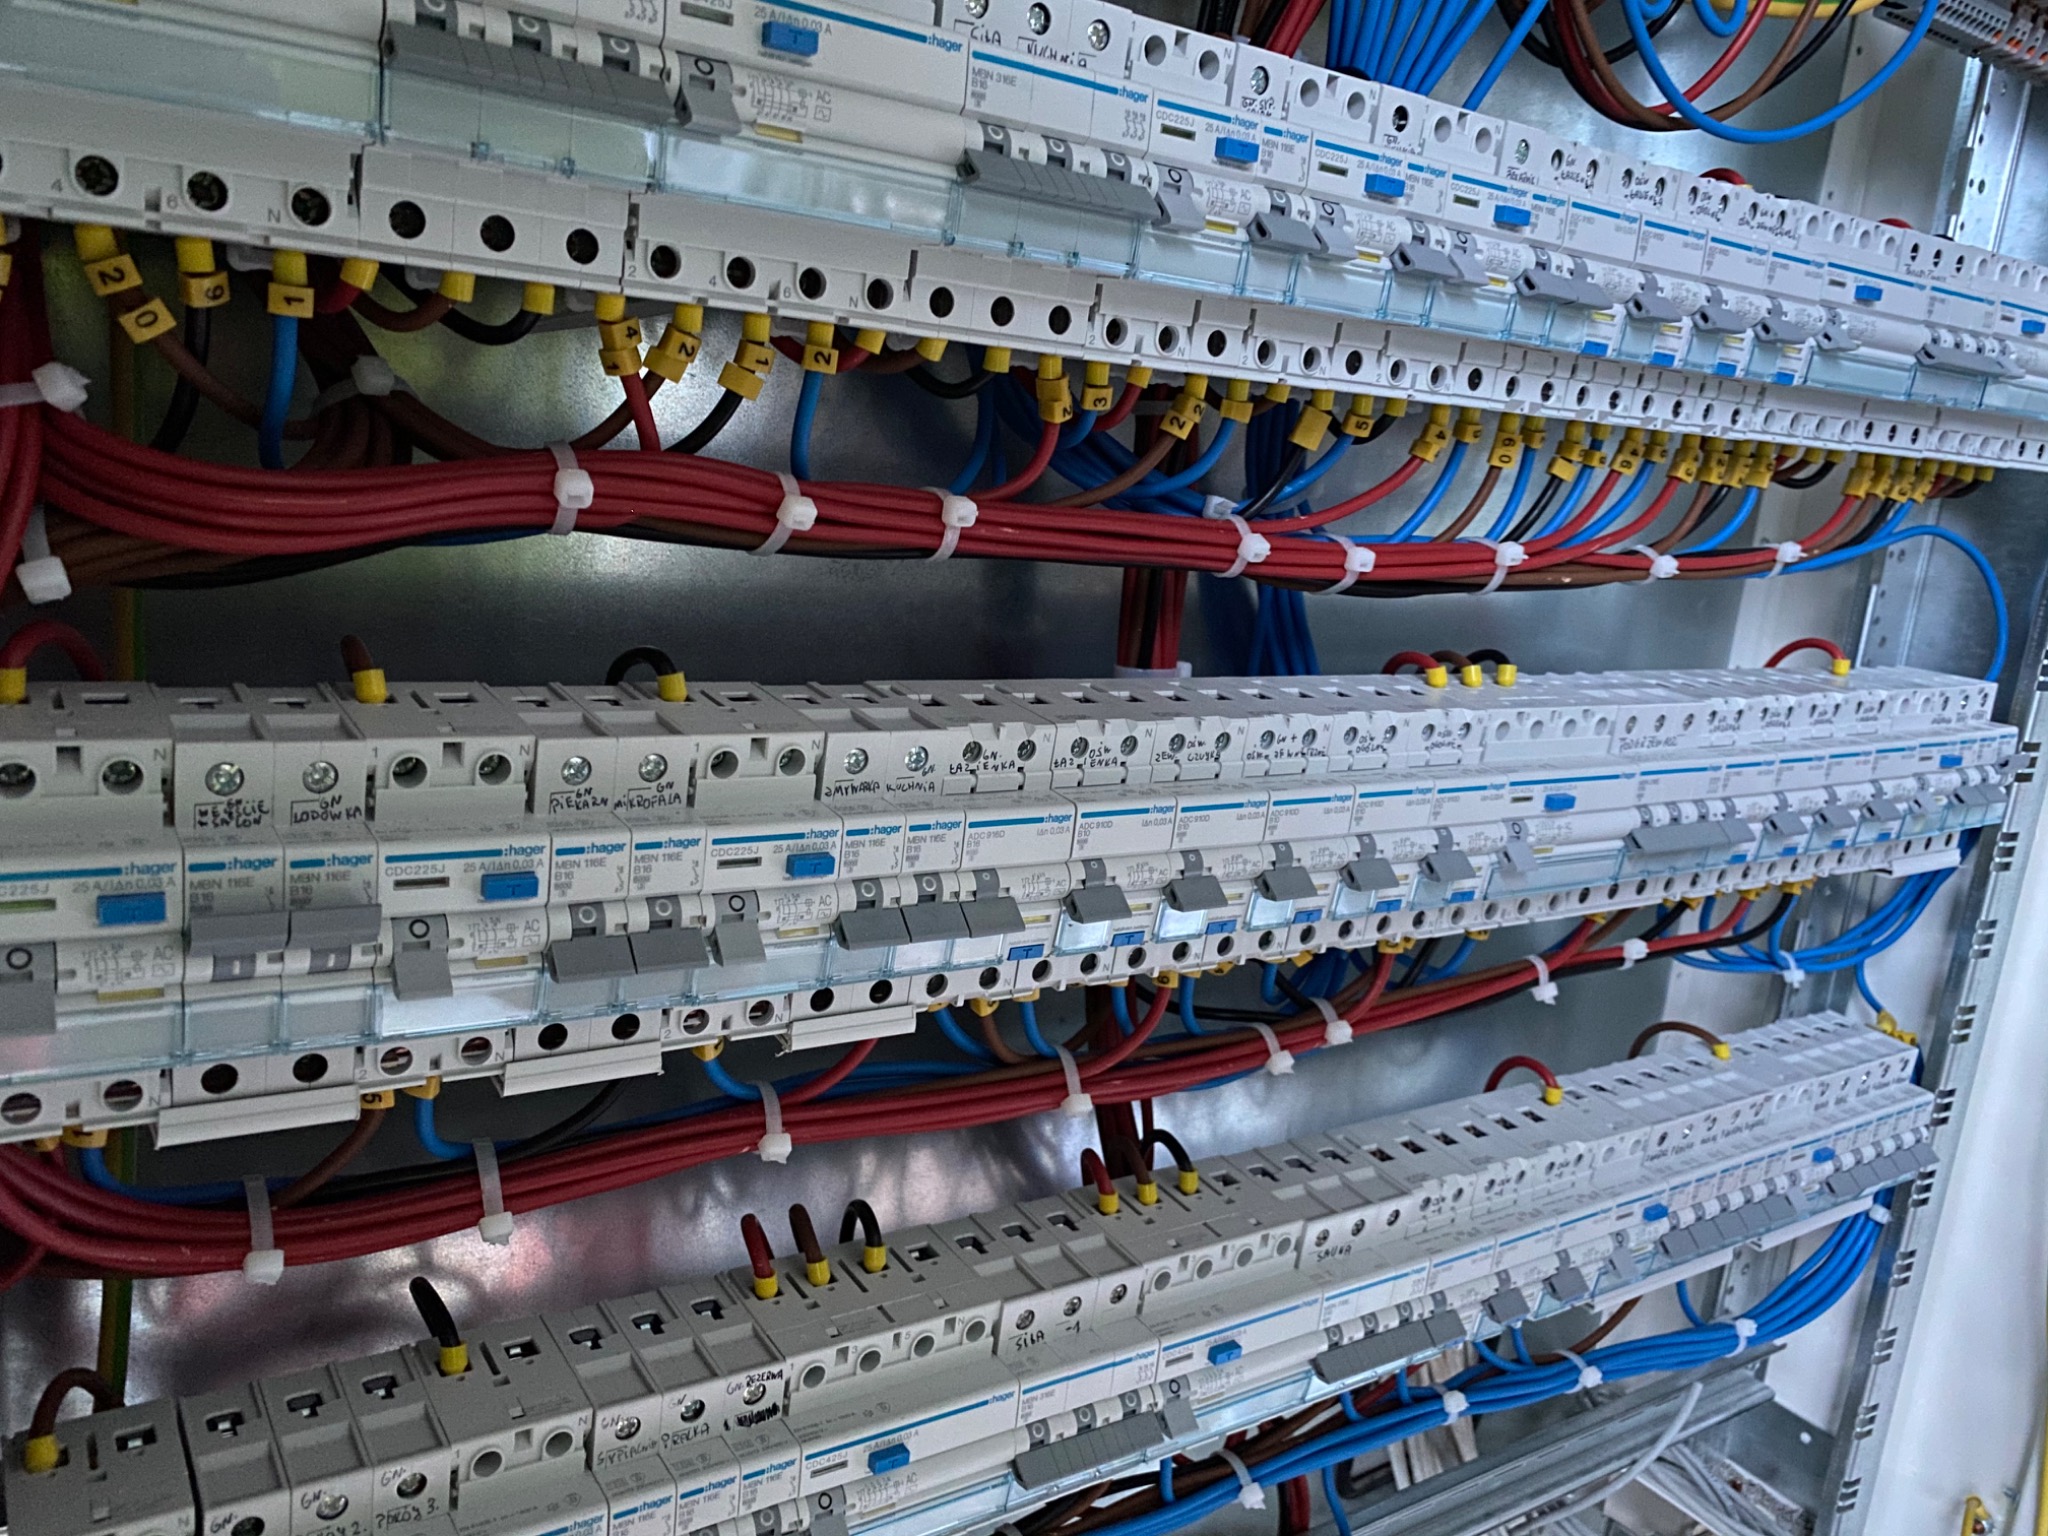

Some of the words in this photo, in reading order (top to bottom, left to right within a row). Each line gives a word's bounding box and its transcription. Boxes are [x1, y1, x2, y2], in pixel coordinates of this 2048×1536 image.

[1223, 47, 1232, 60] N
[816, 90, 831, 103] AC
[1156, 110, 1195, 128] CDC225J
[1315, 149, 1349, 164] CDC225J
[167, 194, 178, 208] 6
[268, 208, 281, 223] N
[628, 265, 636, 277] 2
[709, 275, 717, 287] 4
[783, 287, 791, 298] 6
[850, 296, 858, 308] N
[814, 351, 832, 366] 2
[1093, 396, 1108, 408] 3
[1355, 419, 1370, 431] 5
[1043, 733, 1051, 743] N
[1145, 728, 1153, 738] N
[520, 745, 530, 754] N
[812, 740, 820, 749] N
[154, 748, 166, 760] N
[1044, 813, 1073, 825] :hager
[869, 825, 902, 836] :hager
[931, 820, 963, 831] :hager
[806, 828, 840, 841] :hager
[585, 842, 627, 855] :hager
[664, 837, 702, 850] :hager
[503, 845, 546, 857] :hager
[711, 846, 759, 858] CDC225J
[228, 857, 277, 871] :hager
[326, 854, 373, 867] :hager
[555, 860, 581, 870] MBN
[584, 858, 607, 868] 116E
[634, 853, 659, 864] MBN
[662, 852, 683, 862] 116E
[124, 862, 177, 875] :hager
[385, 865, 445, 876] CDC225J
[463, 863, 477, 873] 25
[536, 860, 544, 868] A
[633, 865, 652, 875] B16
[554, 871, 574, 880] B16
[167, 877, 176, 887] A
[506, 884, 521, 896] T
[818, 895, 832, 906] AC
[523, 920, 540, 931] AC
[775, 1013, 783, 1022] N
[664, 1029, 671, 1038] 2
[496, 1051, 504, 1061] N
[358, 1069, 367, 1080] 2
[958, 1317, 965, 1326] N
[579, 1416, 587, 1425] N
[765, 1458, 797, 1473] :hager
[805, 1451, 848, 1470] CDC425J
[705, 1476, 737, 1490] :hager
[907, 1472, 918, 1485] AC
[639, 1495, 673, 1511] :hager
